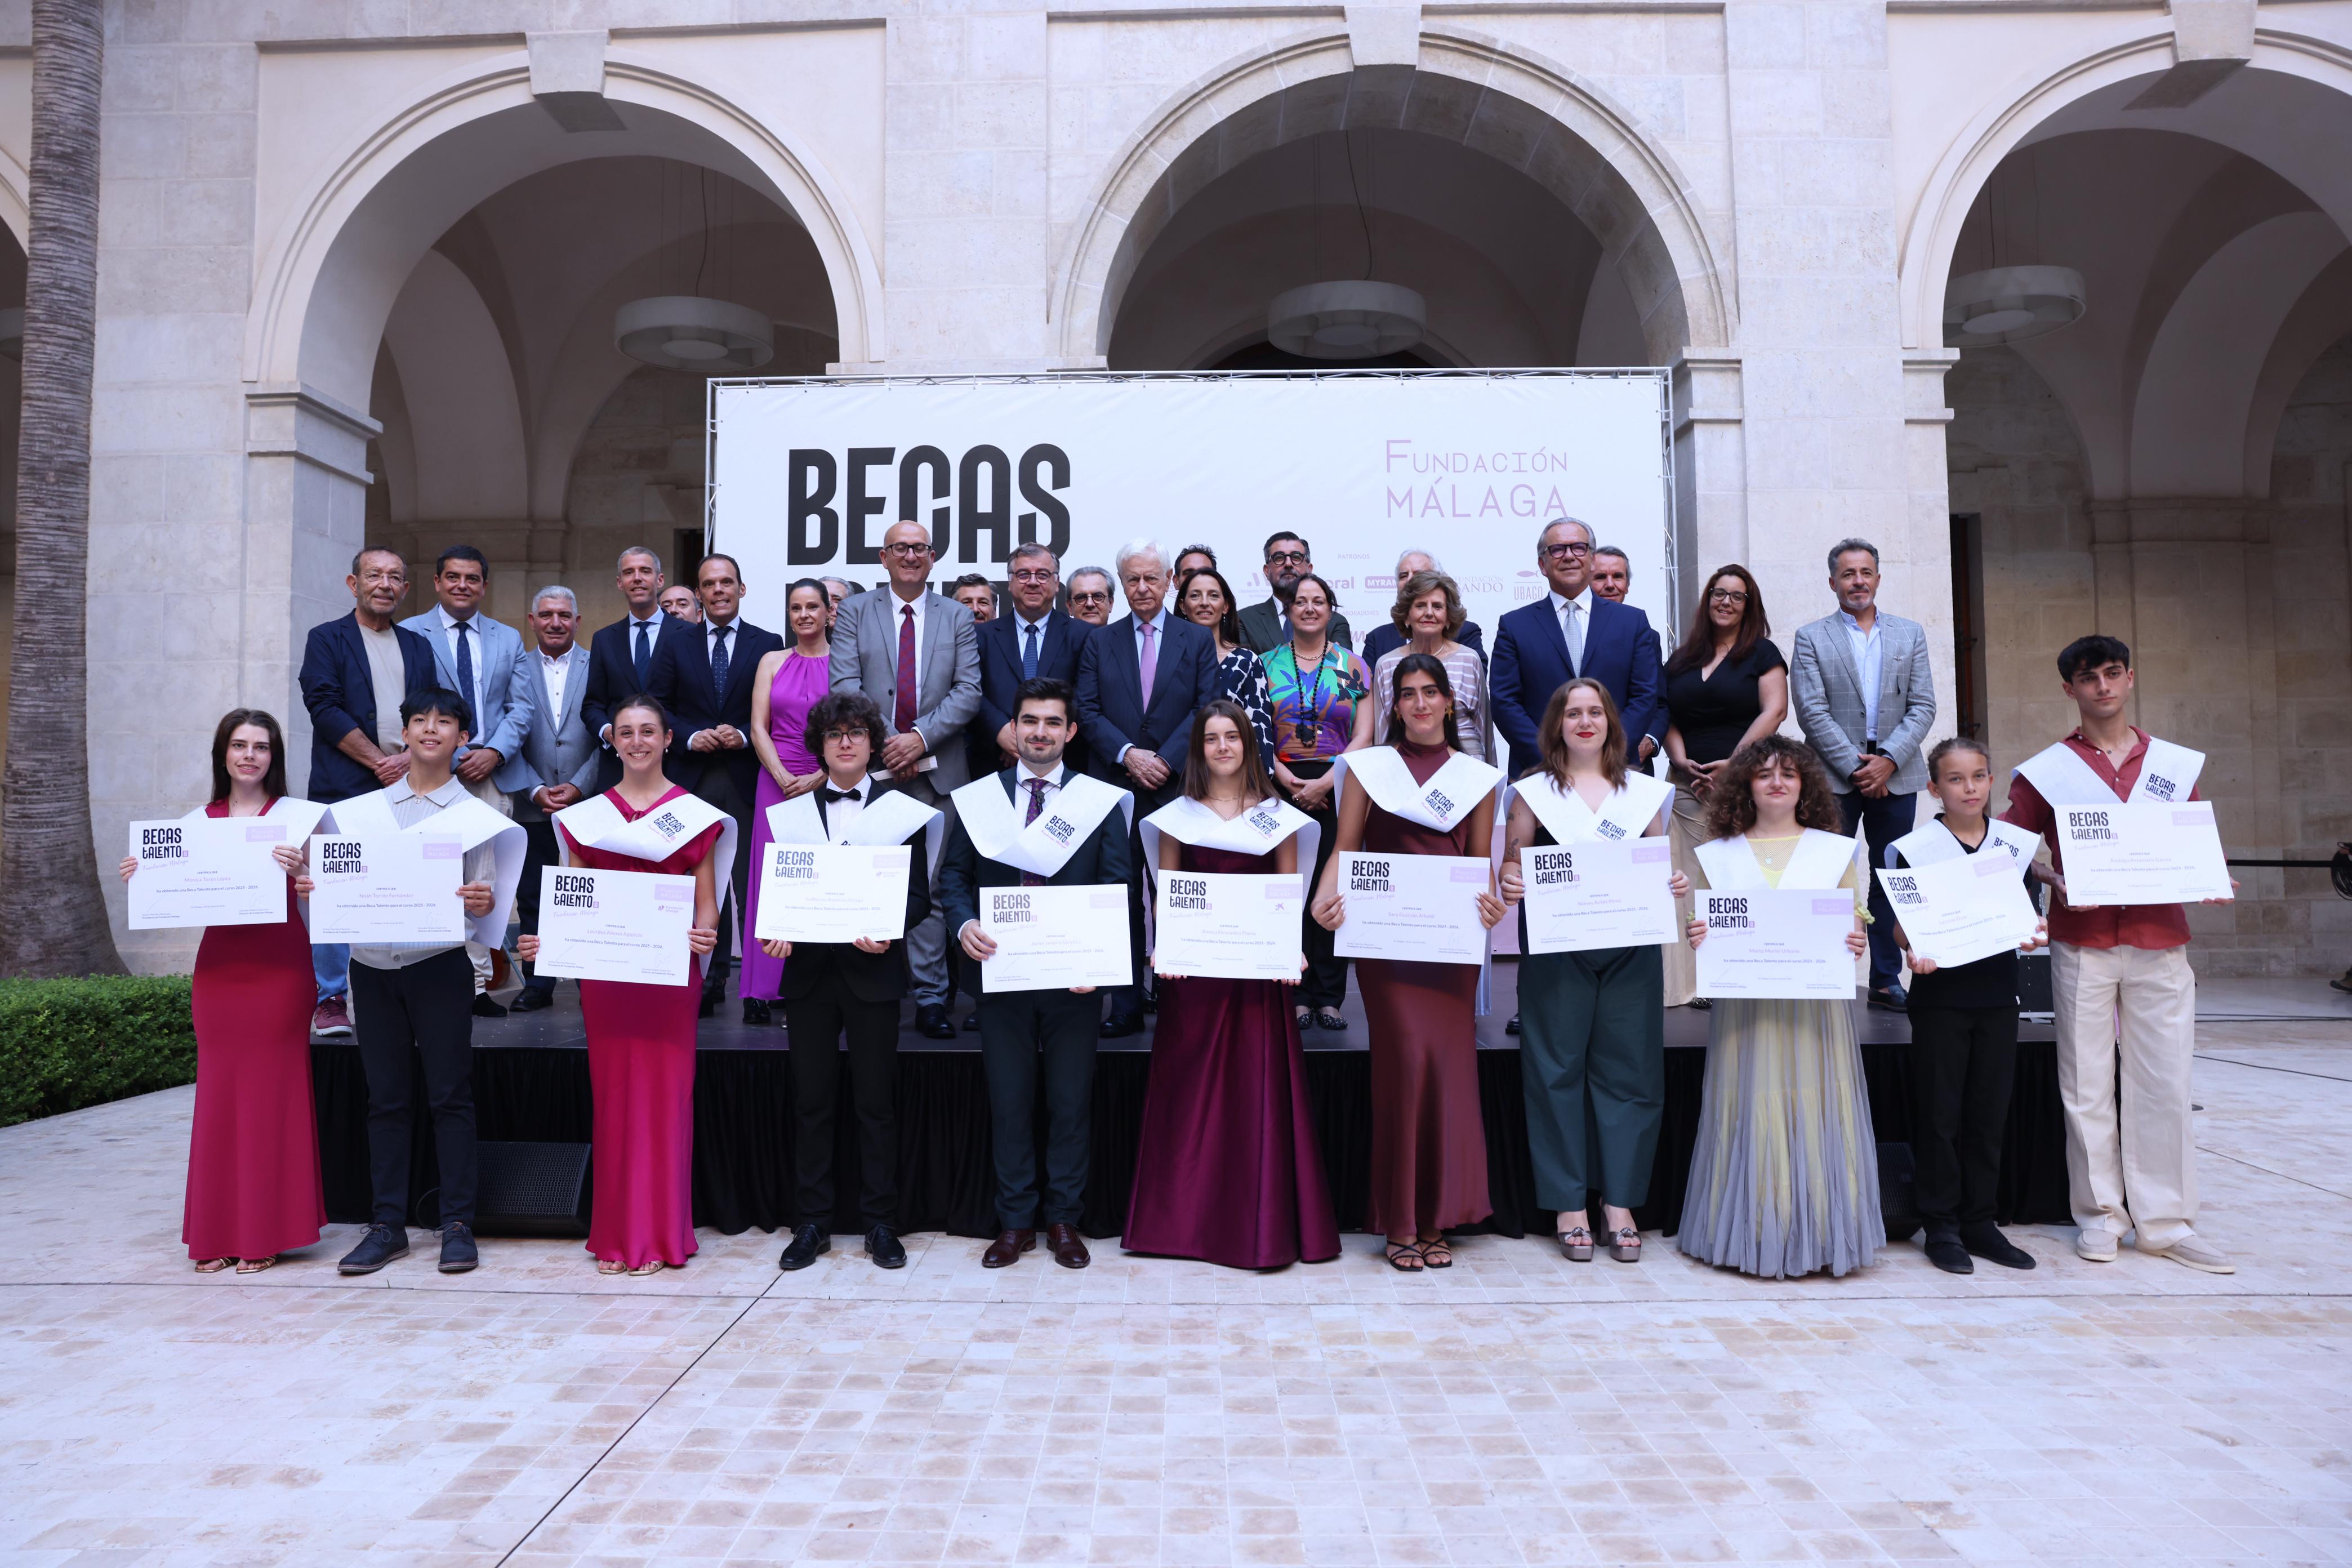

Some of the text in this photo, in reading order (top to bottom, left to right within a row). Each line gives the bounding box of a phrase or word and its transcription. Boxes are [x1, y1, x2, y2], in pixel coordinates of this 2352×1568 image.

[1386, 439, 1568, 473] FUNDACIÓN
[787, 443, 1071, 565] BECAS
[1386, 476, 1568, 518] MÁLAGA
[1514, 586, 1543, 600] UBAGO
[2149, 773, 2176, 793] BECAS
[1431, 789, 1454, 812] BECAS
[661, 812, 685, 832] BECAS
[1050, 816, 1075, 836] BECAS
[1256, 812, 1280, 830] BECAS
[1601, 819, 1627, 837] BECAS
[2069, 812, 2109, 827] BECAS
[142, 827, 181, 845] BECAS
[323, 843, 361, 859] BECAS
[777, 850, 814, 866] BECAS
[1352, 860, 1390, 877] BECAS
[1534, 853, 1572, 871] BECAS
[555, 875, 595, 894] BECAS
[1170, 879, 1206, 896] BECAS
[1887, 876, 1917, 891] BECAS
[993, 894, 1031, 910] BECAS
[1709, 898, 1748, 914] BECAS
